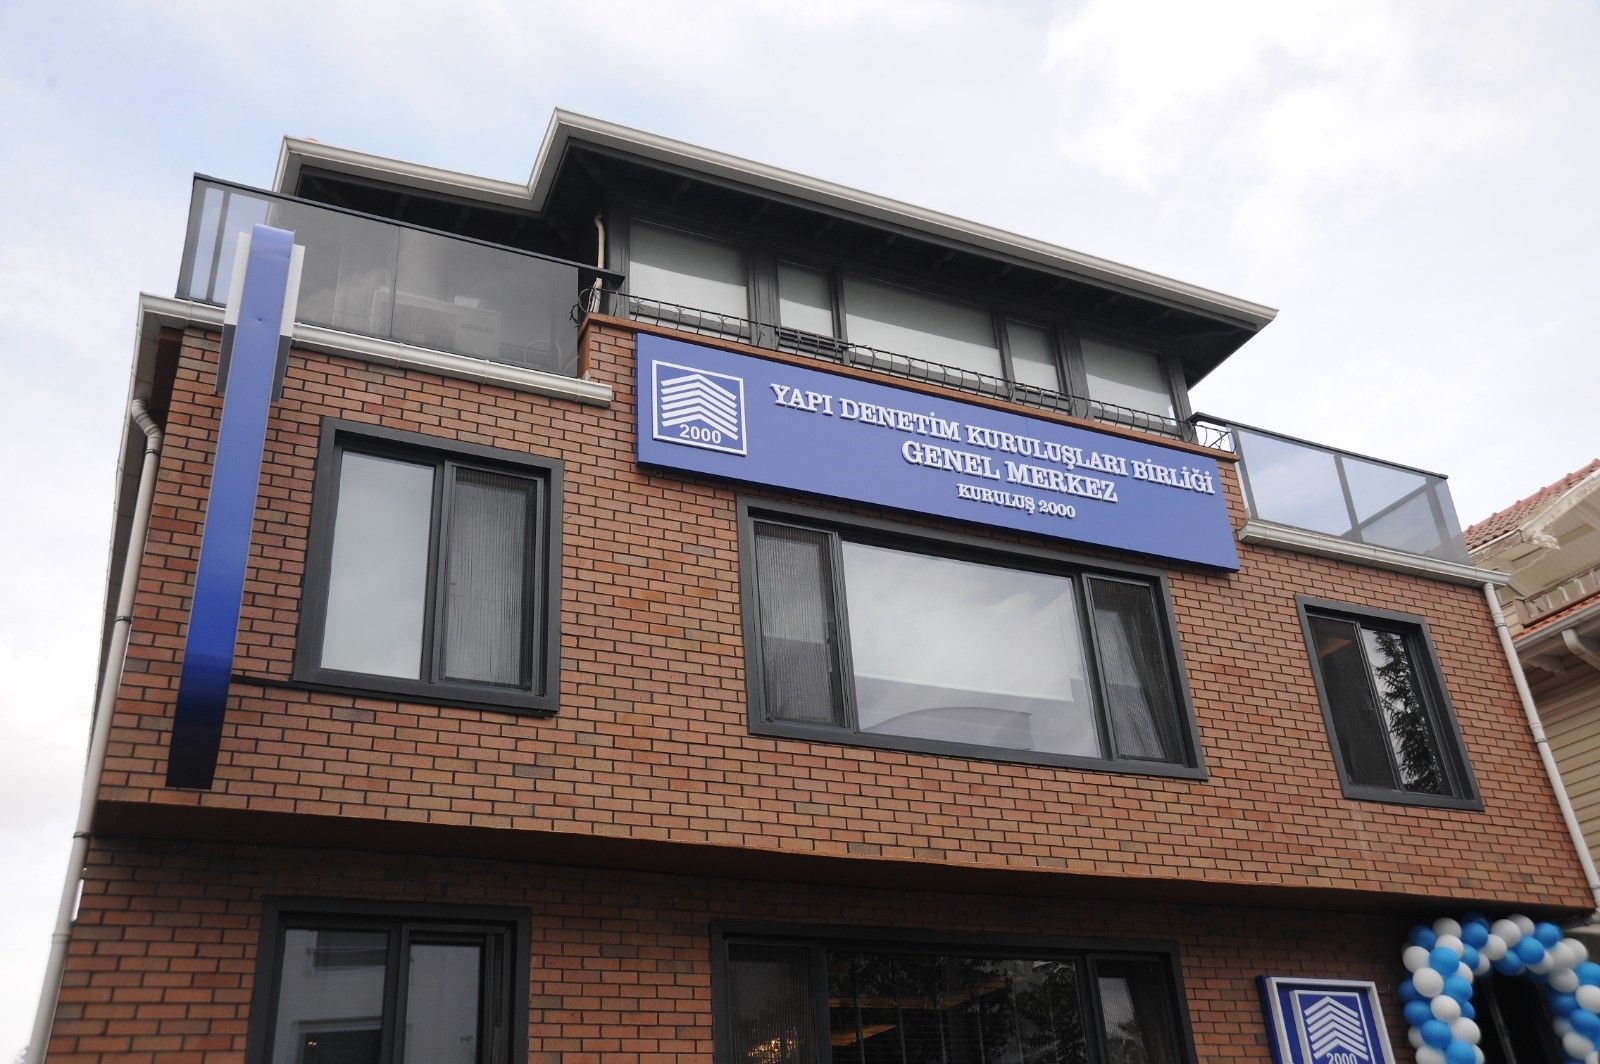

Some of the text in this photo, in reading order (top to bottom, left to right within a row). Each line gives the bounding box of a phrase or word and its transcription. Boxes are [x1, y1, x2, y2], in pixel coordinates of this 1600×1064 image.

[679, 424, 721, 444] 2000
[770, 383, 1216, 495] YAPI DENETİM KURULUŞLARI BİRLİĞİ
[901, 440, 1118, 503] GENEL MERKEZ
[956, 483, 1076, 518] KURULUŞ 2000
[1326, 1052, 1358, 1064] 2000
